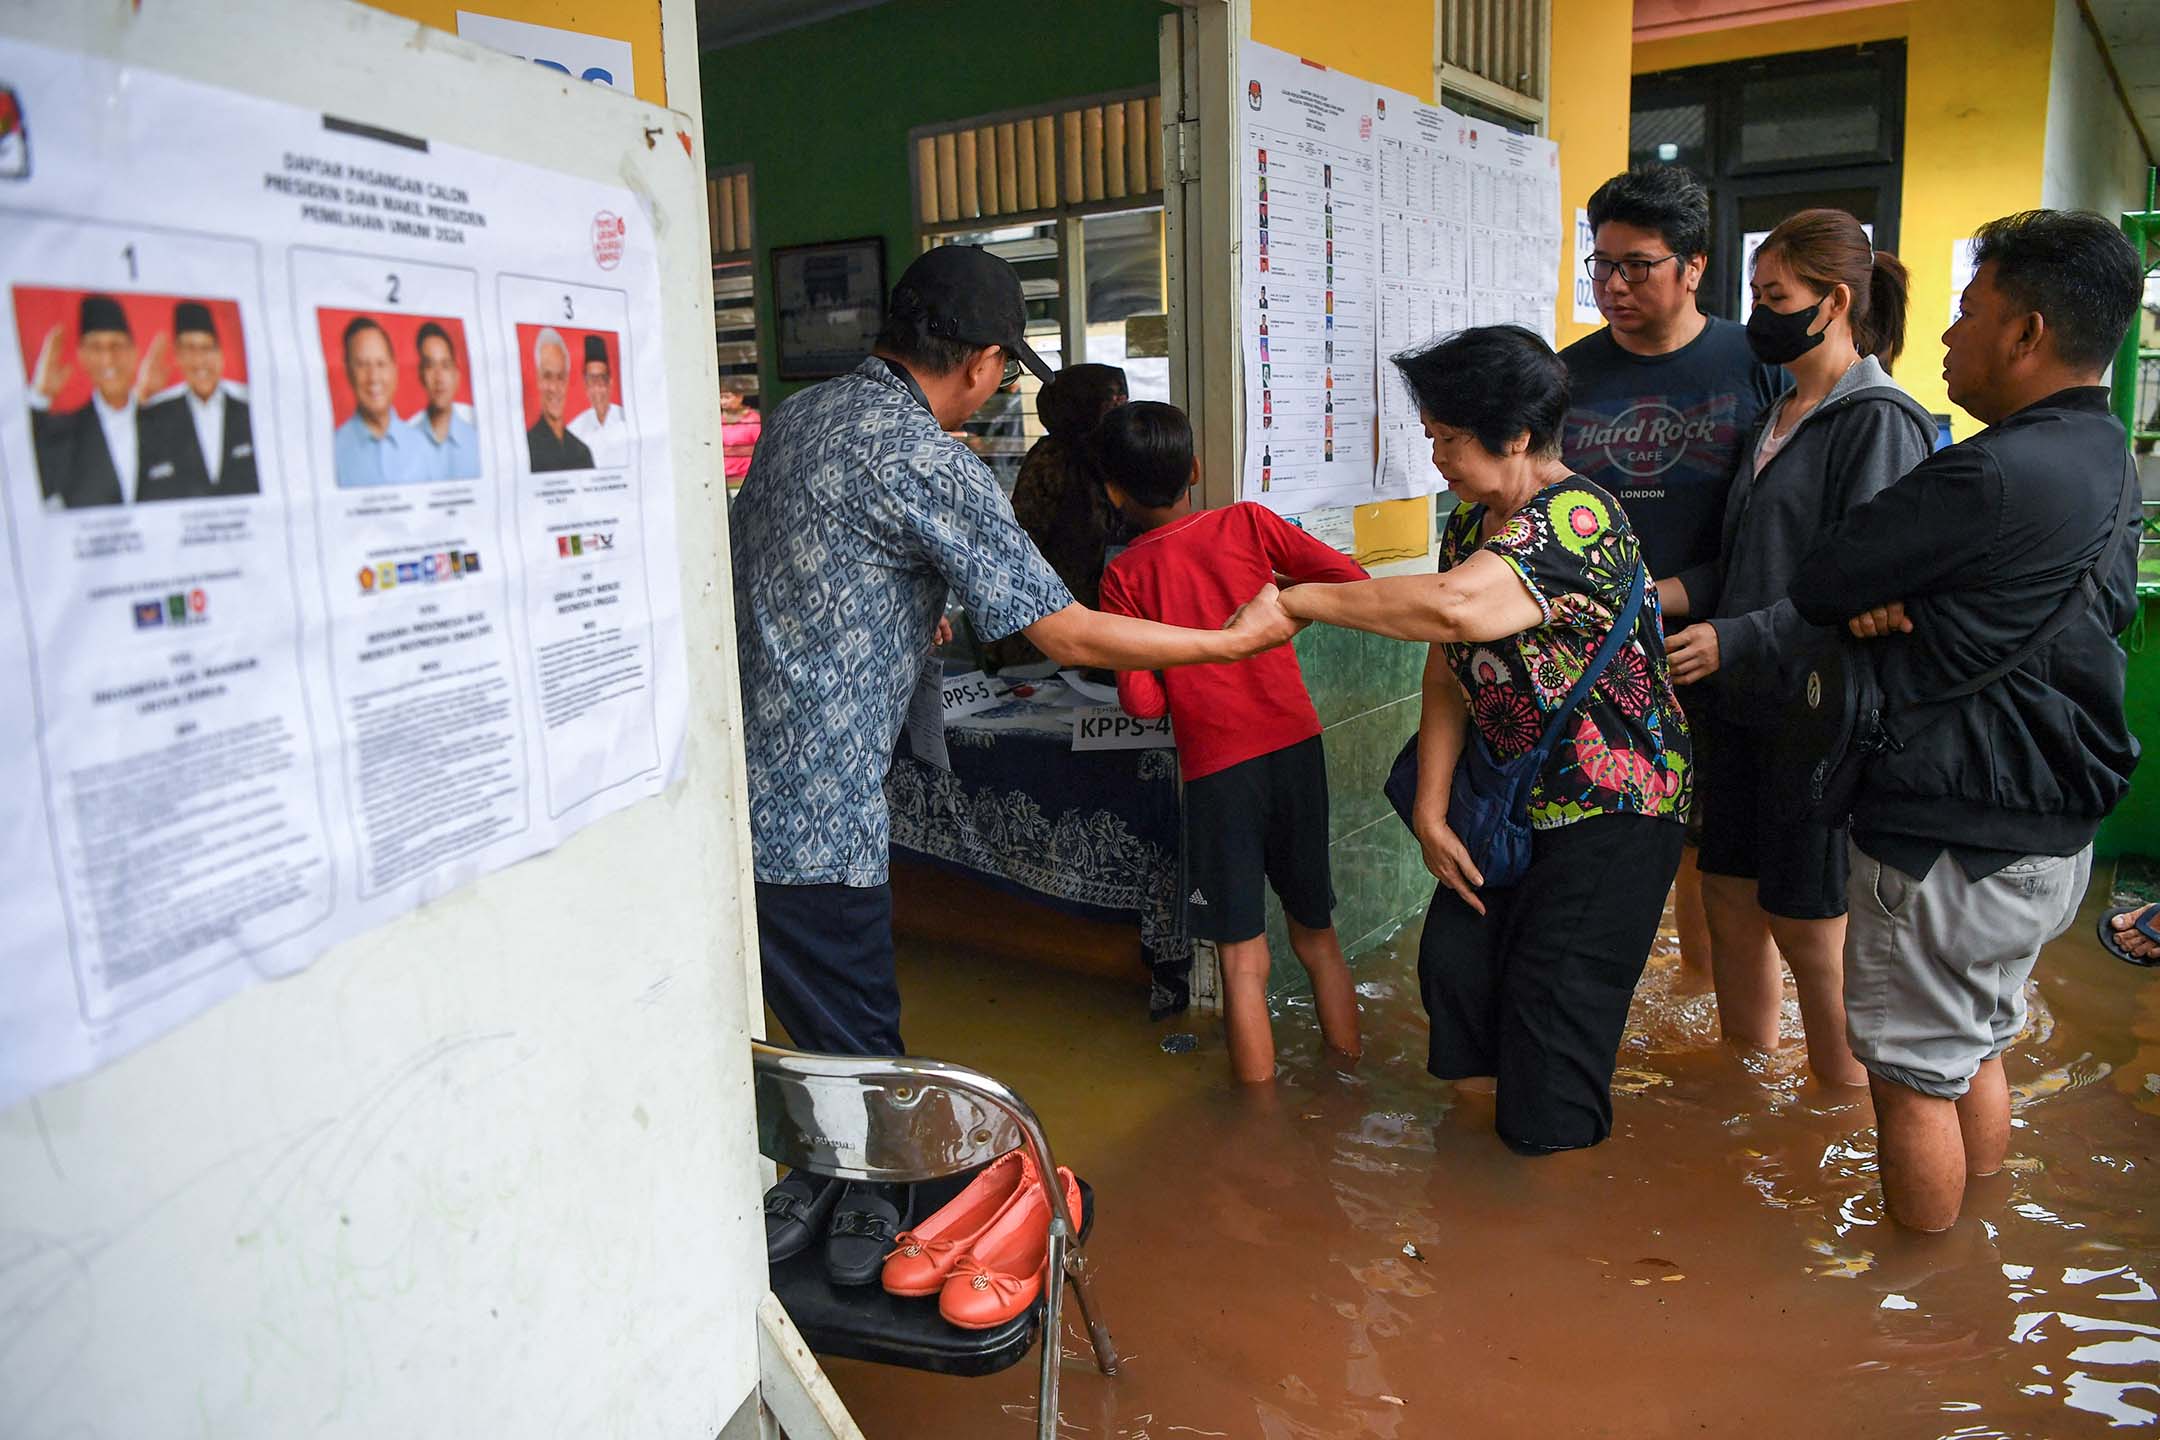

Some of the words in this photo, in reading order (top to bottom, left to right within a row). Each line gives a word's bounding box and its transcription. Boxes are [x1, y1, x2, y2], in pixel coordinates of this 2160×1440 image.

[283, 153, 342, 178] DAFTAR
[349, 166, 423, 194] PASANGAN
[427, 183, 468, 203] CALON
[264, 173, 341, 200] PRESIDEN
[344, 189, 378, 206] DAN
[383, 197, 424, 217] WAKIL
[427, 204, 486, 226] PRESIDEN
[301, 205, 385, 230] PEMILIHAN
[389, 220, 430, 238] UMUM
[121, 243, 139, 281] 1
[386, 273, 399, 304] 2
[1577, 279, 1596, 307] 02
[563, 294, 575, 320] 3
[1576, 417, 1647, 449] Hard
[1649, 414, 1716, 447] Rock
[1627, 451, 1663, 462] CAFE
[1620, 490, 1665, 498] LONDON
[942, 681, 989, 709] PPS-5
[1081, 713, 1170, 738] KPPS-4
